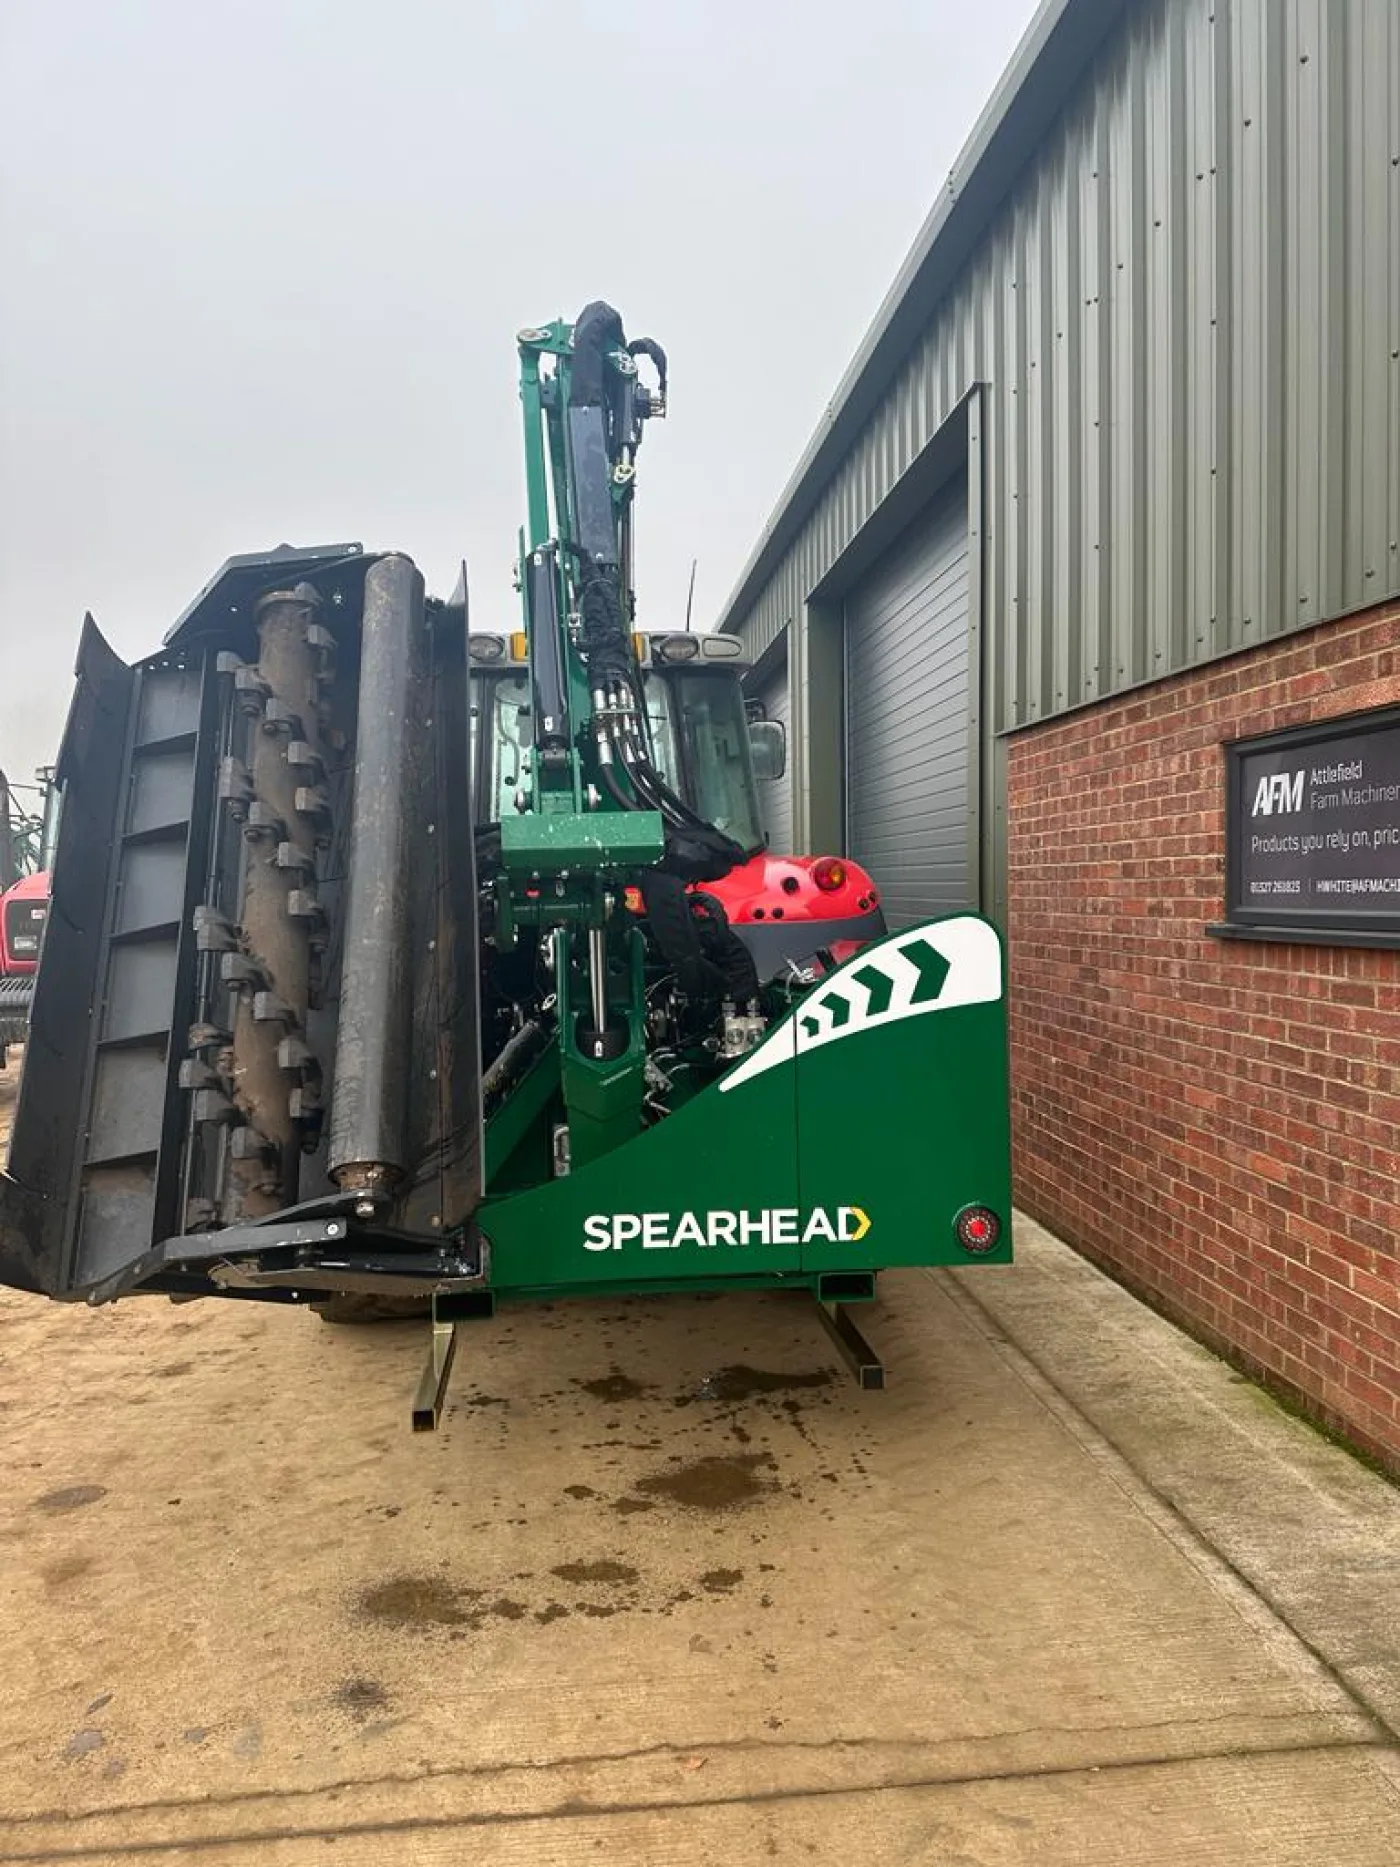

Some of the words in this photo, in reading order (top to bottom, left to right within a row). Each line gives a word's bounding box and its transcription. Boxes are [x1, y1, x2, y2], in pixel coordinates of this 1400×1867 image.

[1310, 760, 1362, 786] Attlefield
[1251, 770, 1305, 817] AFM
[1310, 791, 1339, 809] Farm
[1251, 834, 1299, 853] Products
[1301, 834, 1324, 855] you
[1326, 828, 1350, 852] rely
[583, 1206, 872, 1251] SPEARHEAD
